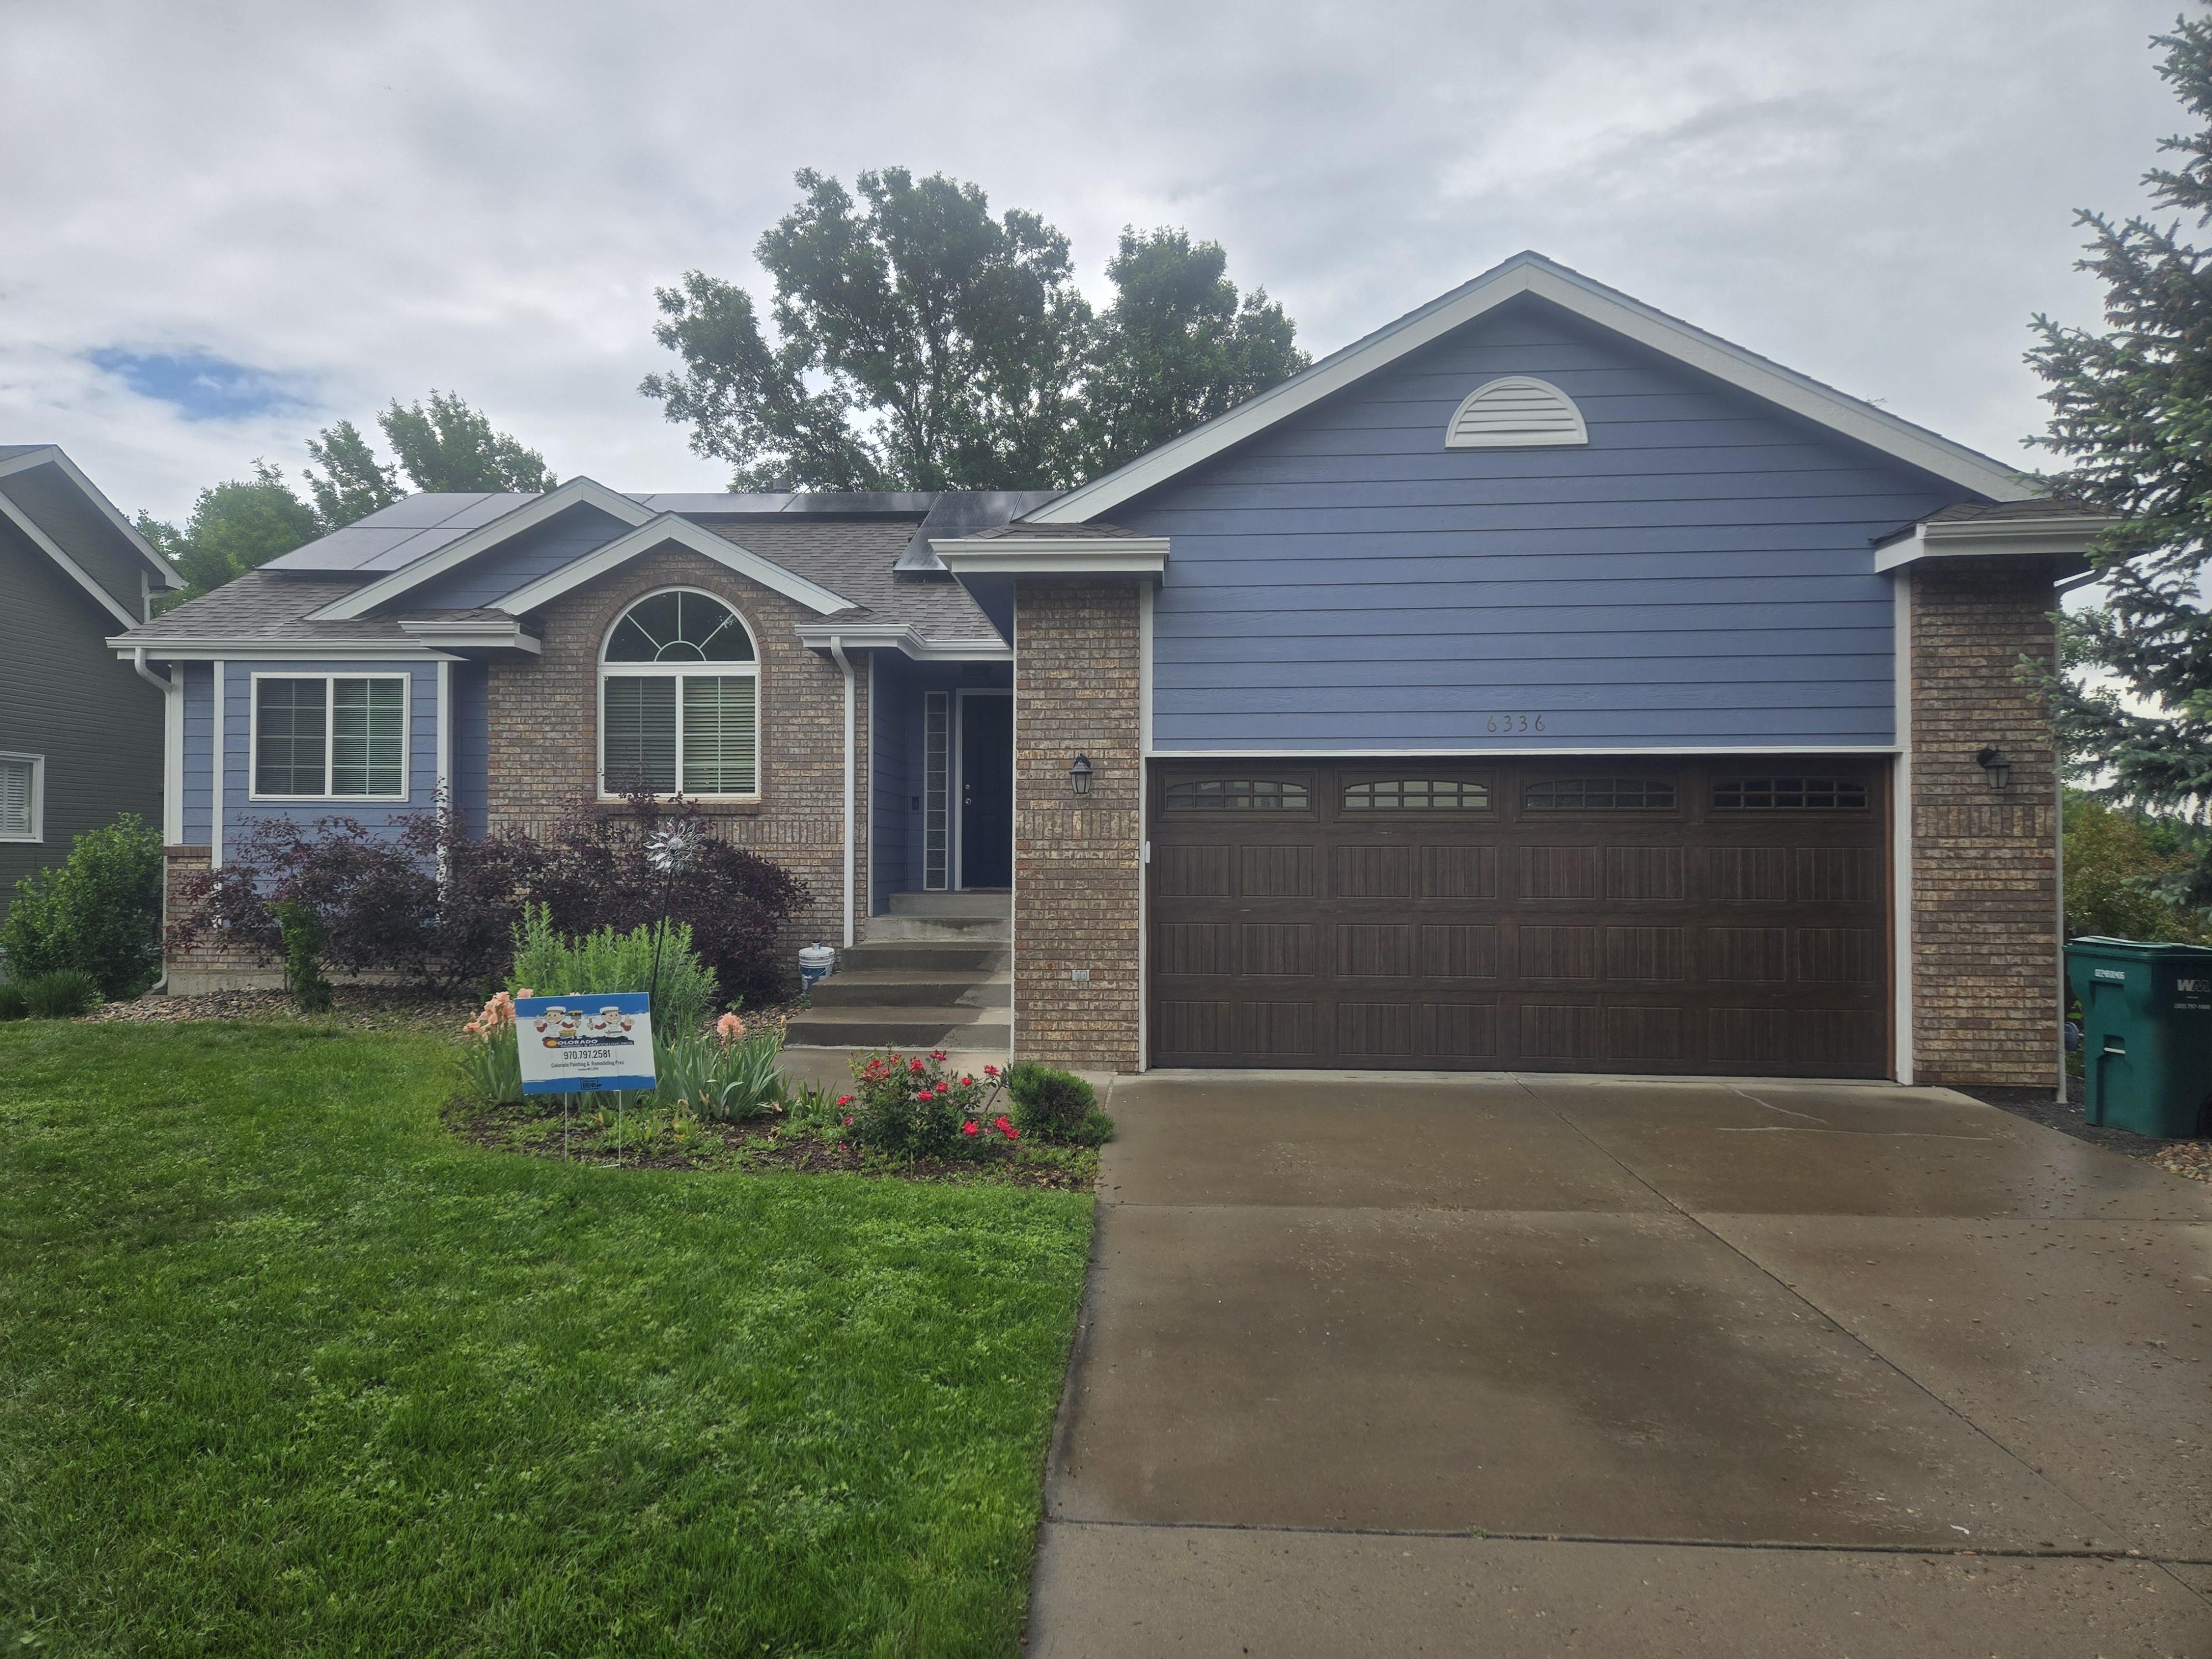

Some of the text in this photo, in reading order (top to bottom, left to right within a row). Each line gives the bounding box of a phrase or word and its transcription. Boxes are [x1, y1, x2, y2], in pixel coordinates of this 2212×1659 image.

[1486, 713, 1546, 733] 6336
[2177, 979, 2210, 992] WM
[564, 1050, 611, 1060] 970.797.2581
